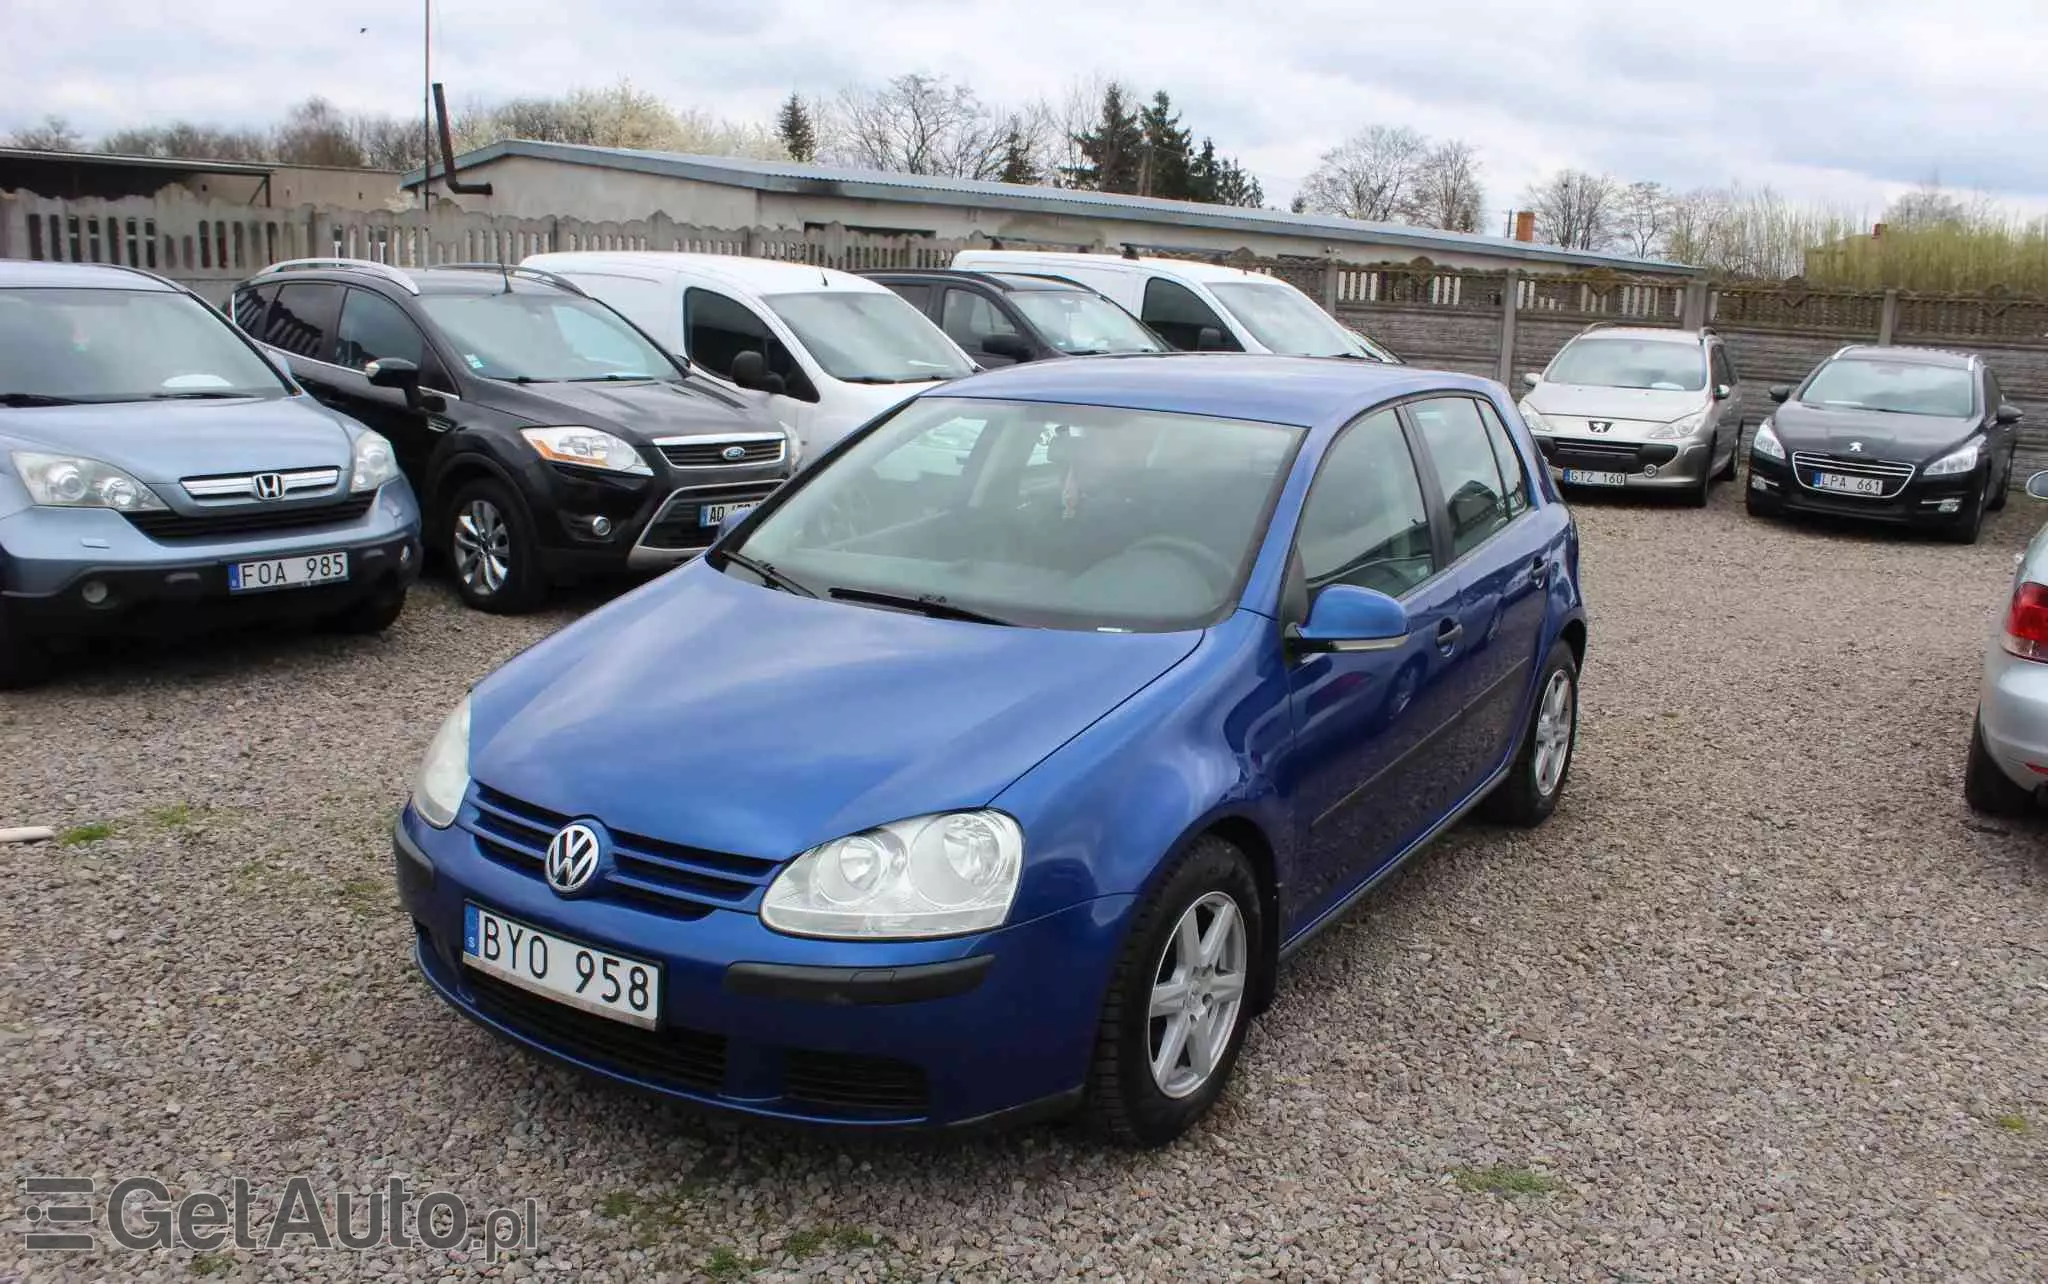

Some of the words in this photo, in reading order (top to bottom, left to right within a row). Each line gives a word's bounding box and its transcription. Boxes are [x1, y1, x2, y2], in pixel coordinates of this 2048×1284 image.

[1571, 471, 1594, 483] GTZ
[1603, 472, 1624, 484] 160
[1822, 474, 1847, 489] LPA
[1857, 479, 1880, 493] 661
[241, 562, 287, 587] FOA
[306, 554, 344, 579] 985
[484, 915, 548, 980] BYO
[575, 950, 649, 1012] 958
